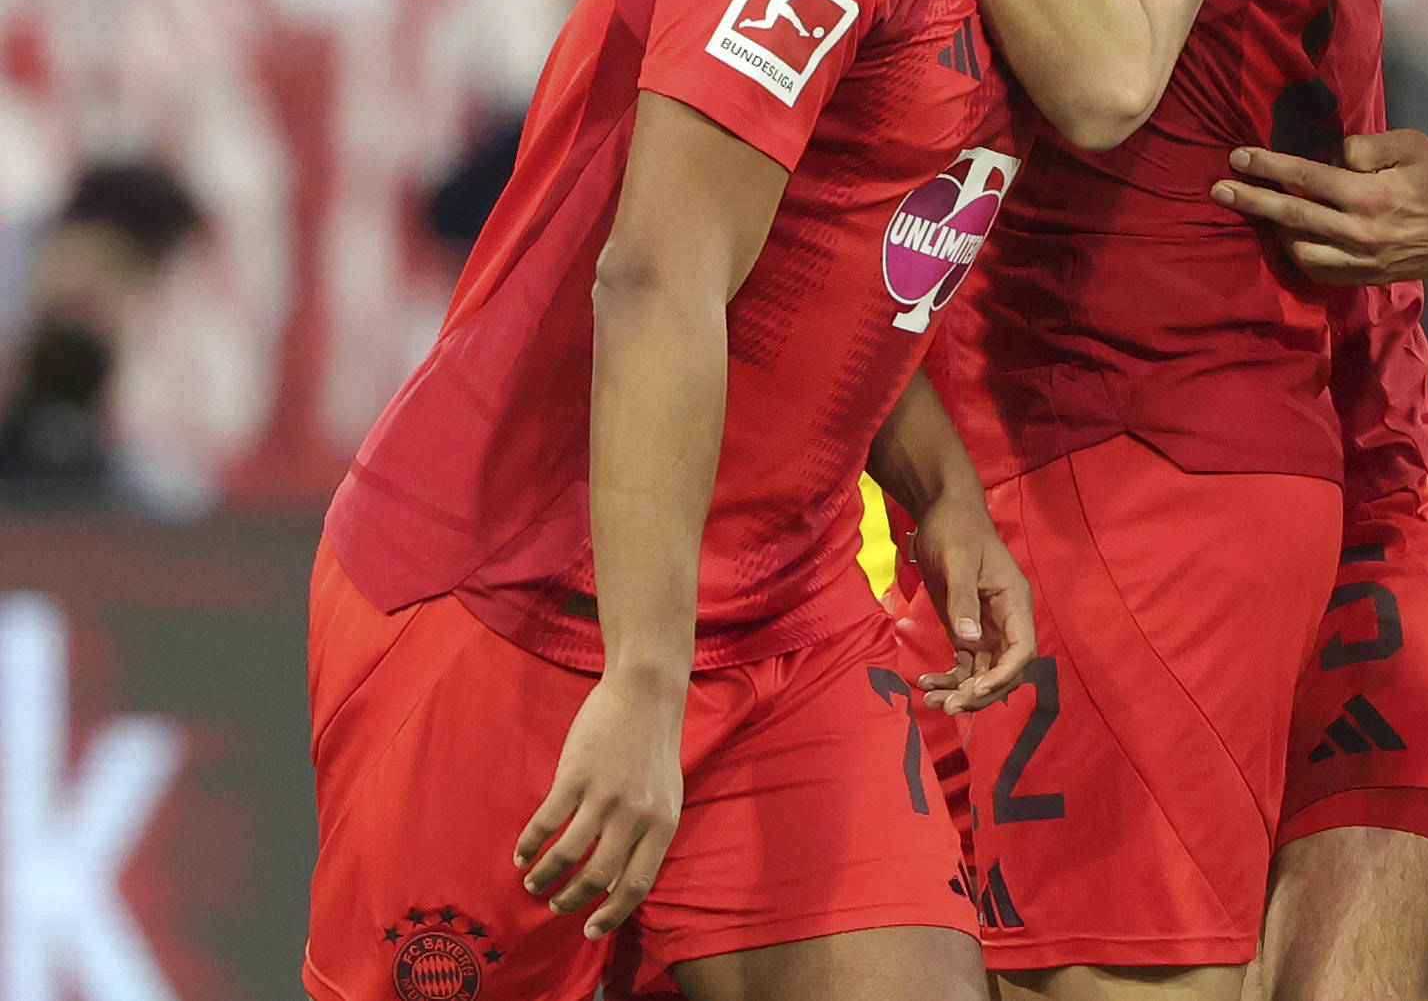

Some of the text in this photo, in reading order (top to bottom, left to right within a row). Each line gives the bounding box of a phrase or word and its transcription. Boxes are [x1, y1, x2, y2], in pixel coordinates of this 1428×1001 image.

[720, 37, 795, 93] BUNDESLIGA
[889, 212, 985, 265] UNLIMITE
[971, 655, 1066, 825] 2
[403, 938, 476, 978] FC BAYERN
